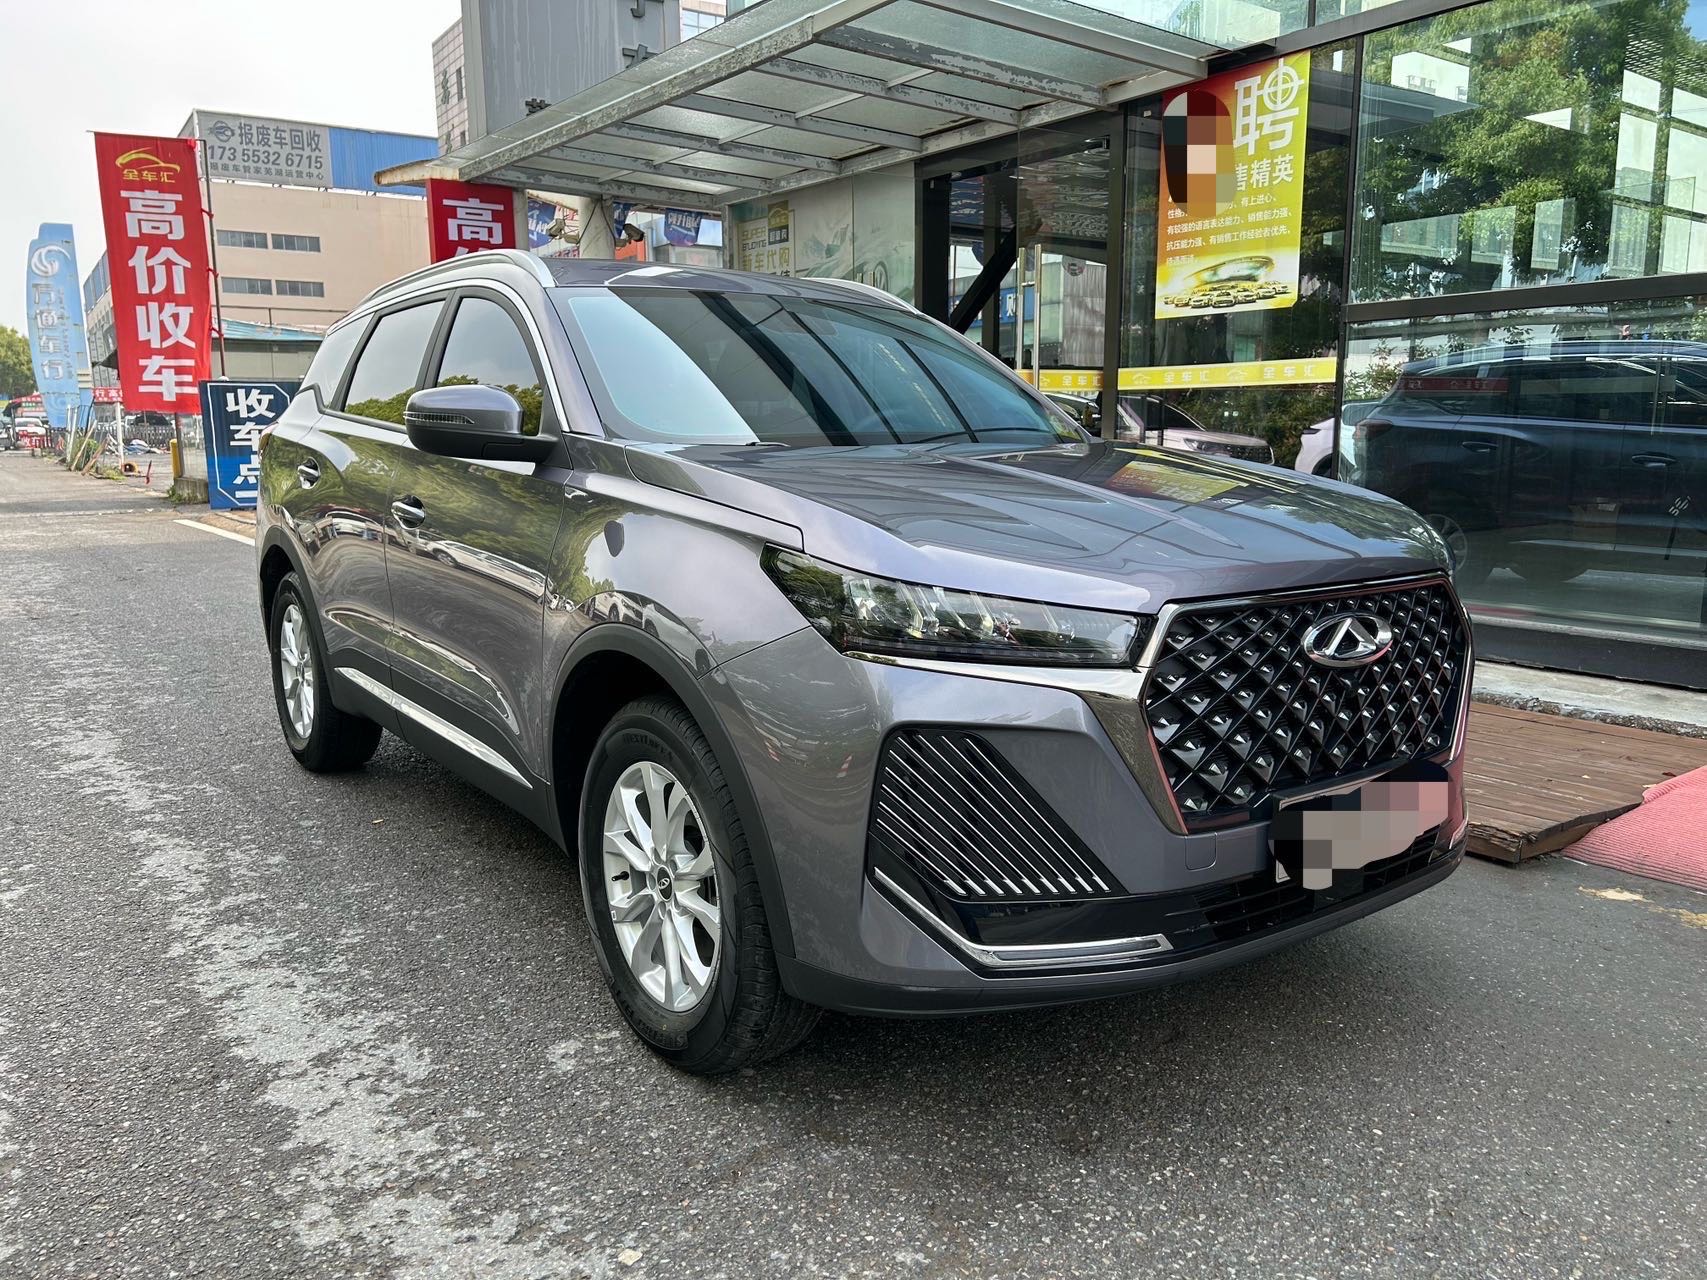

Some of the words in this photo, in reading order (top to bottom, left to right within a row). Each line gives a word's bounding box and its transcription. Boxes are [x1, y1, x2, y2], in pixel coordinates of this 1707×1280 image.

[1233, 58, 1304, 156] 聘
[238, 121, 322, 153] 报废车回收
[207, 145, 237, 162] 173
[241, 148, 281, 166] 5532
[285, 152, 324, 170] 6715
[122, 168, 176, 183] 全车汇
[442, 196, 505, 255] 高
[119, 189, 199, 402] 高价收车
[1061, 375, 1102, 387] 全车汇
[1162, 371, 1211, 384] 全车汇
[1262, 364, 1317, 380] 全车汇
